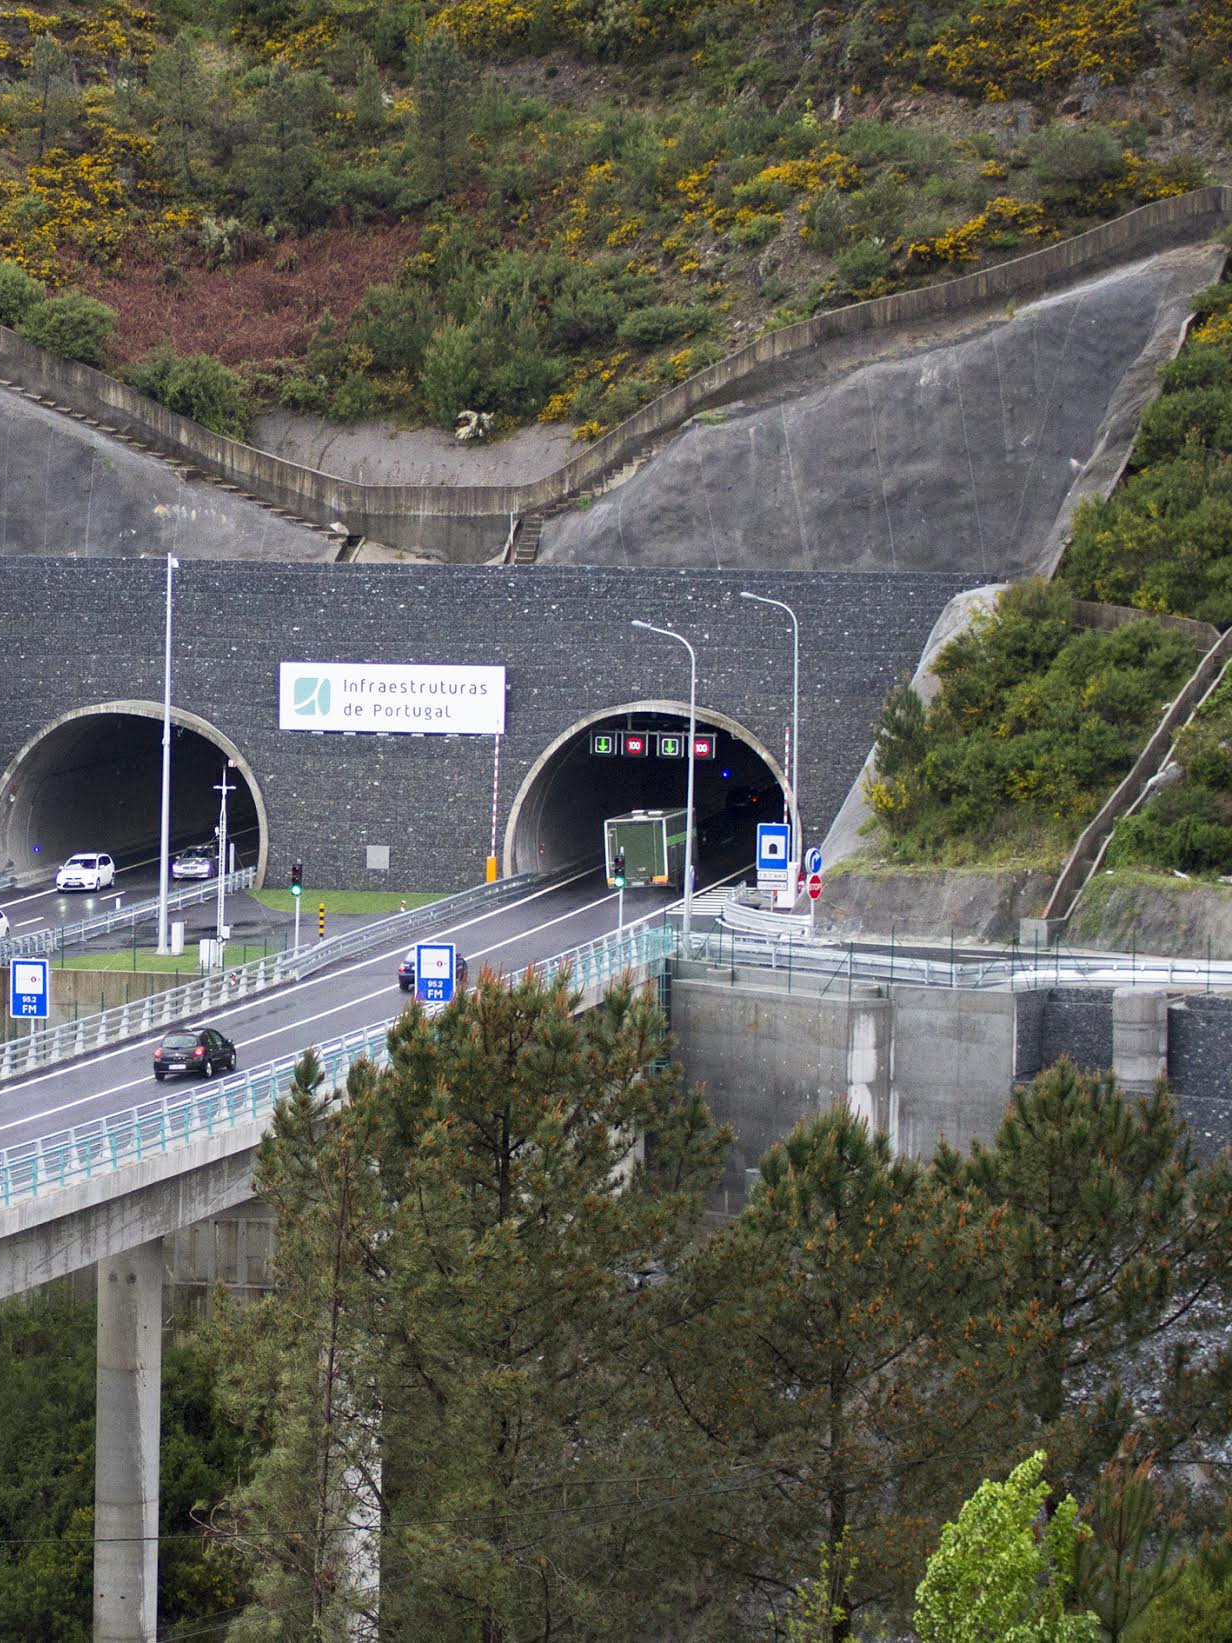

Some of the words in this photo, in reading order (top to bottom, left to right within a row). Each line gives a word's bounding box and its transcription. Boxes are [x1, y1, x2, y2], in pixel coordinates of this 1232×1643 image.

[343, 679, 488, 695] Infraestruturas
[343, 703, 363, 716] de
[373, 704, 451, 720] Portugal
[628, 741, 641, 750] 100
[695, 743, 708, 752] 100
[427, 989, 443, 998] FM
[22, 1004, 37, 1014] FM
